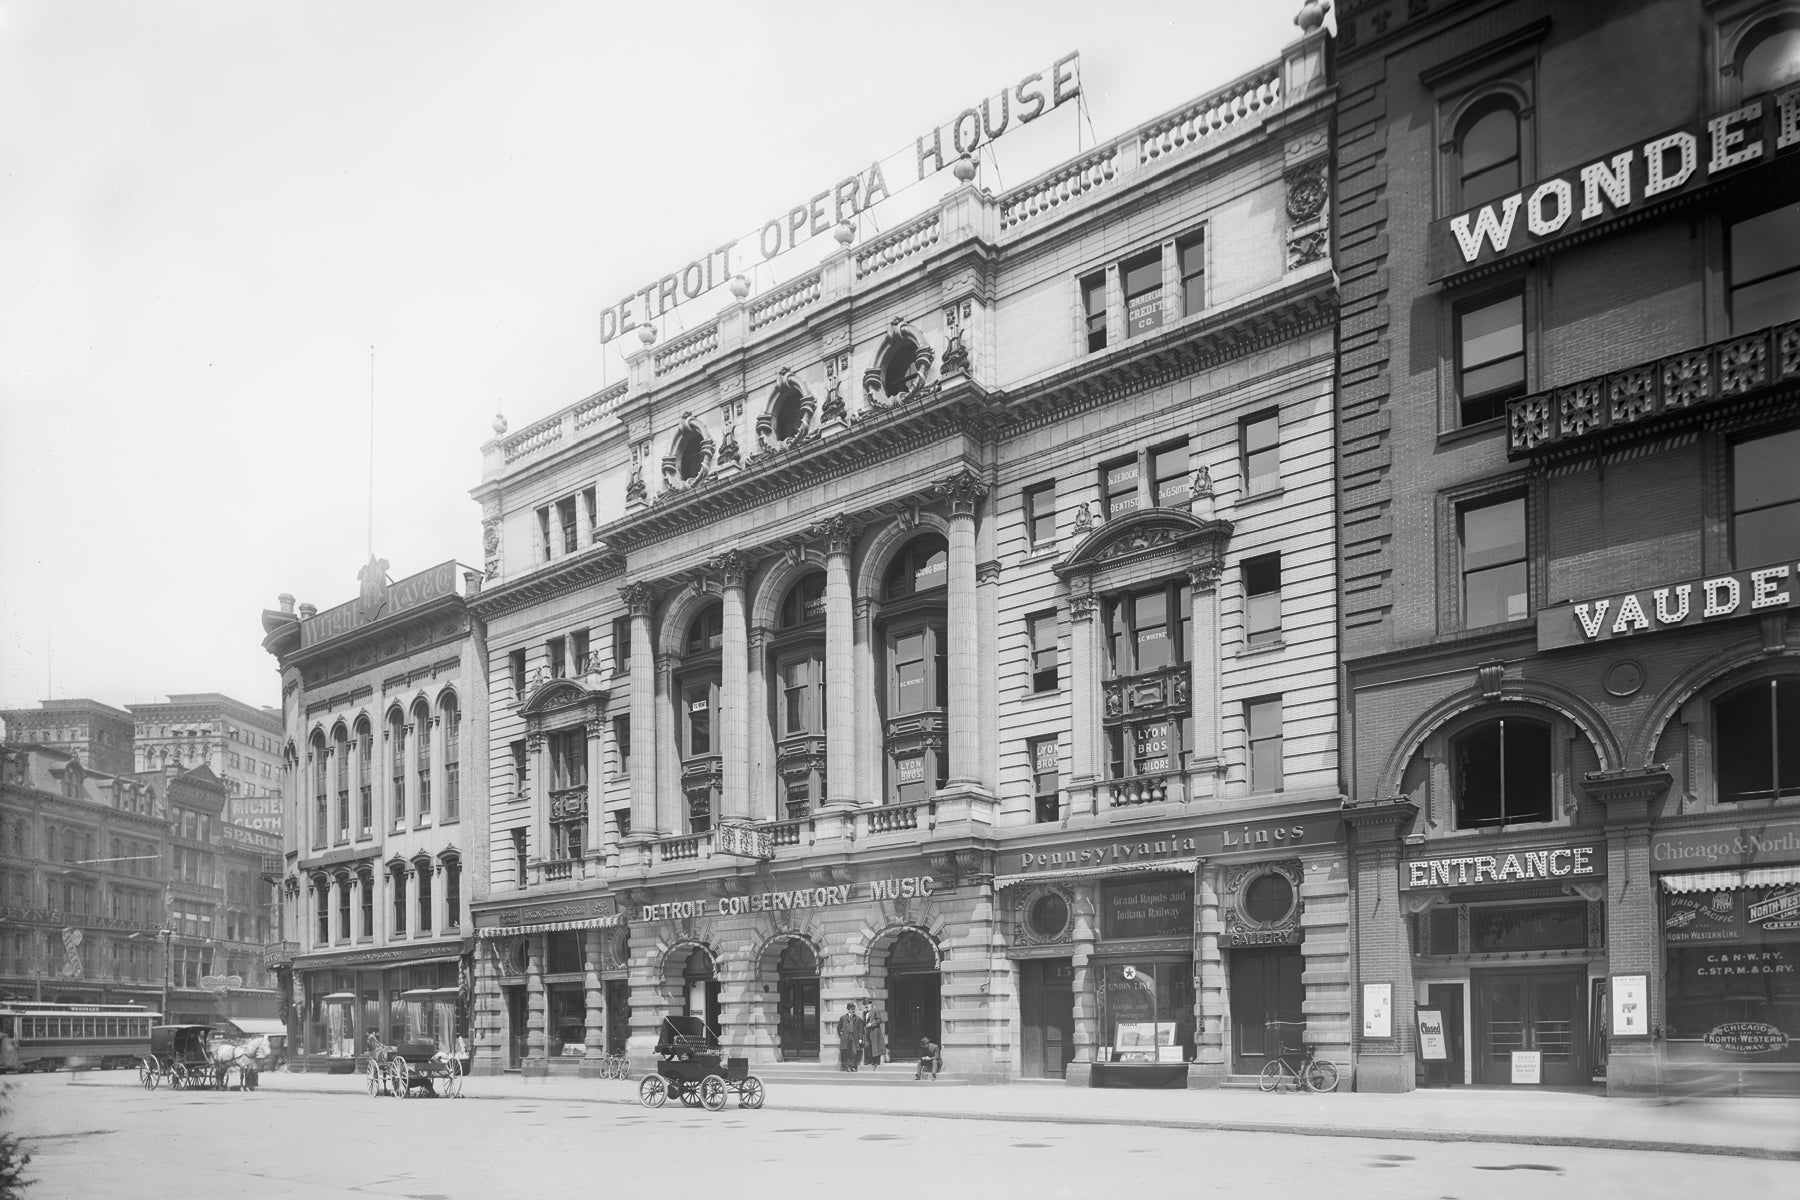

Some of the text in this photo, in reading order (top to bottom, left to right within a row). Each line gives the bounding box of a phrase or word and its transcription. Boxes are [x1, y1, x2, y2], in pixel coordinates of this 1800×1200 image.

[600, 49, 1080, 345] DETROIT OPERA HOUSE
[1129, 300, 1163, 322] CREDIT
[1138, 317, 1155, 328] CO.
[1111, 497, 1139, 513] DENTIST
[1575, 562, 1800, 638] VAUDE
[1138, 726, 1167, 740] LYON
[1037, 743, 1059, 756] LYON
[1138, 740, 1169, 754] BROS.
[900, 760, 921, 770] LYON
[1037, 757, 1058, 769] BROS
[1138, 759, 1169, 772] TAILORS
[1020, 824, 1305, 868] Pennsylvania Lines
[1653, 841, 1730, 862] Chicago
[1732, 836, 1748, 854] &
[1408, 846, 1593, 888] ENTRANCE
[642, 875, 934, 922] DETROIT CONSERVATORY MUSIC
[1113, 890, 1186, 906] Grand Rapids and
[1116, 906, 1179, 920] Indiana Railway
[1671, 897, 1700, 910] UNION
[1699, 905, 1735, 923] PACIFIC
[1231, 929, 1291, 946] GALLERY
[1109, 981, 1152, 991] UNION LINE
[1723, 1024, 1767, 1033] CHICAGO
